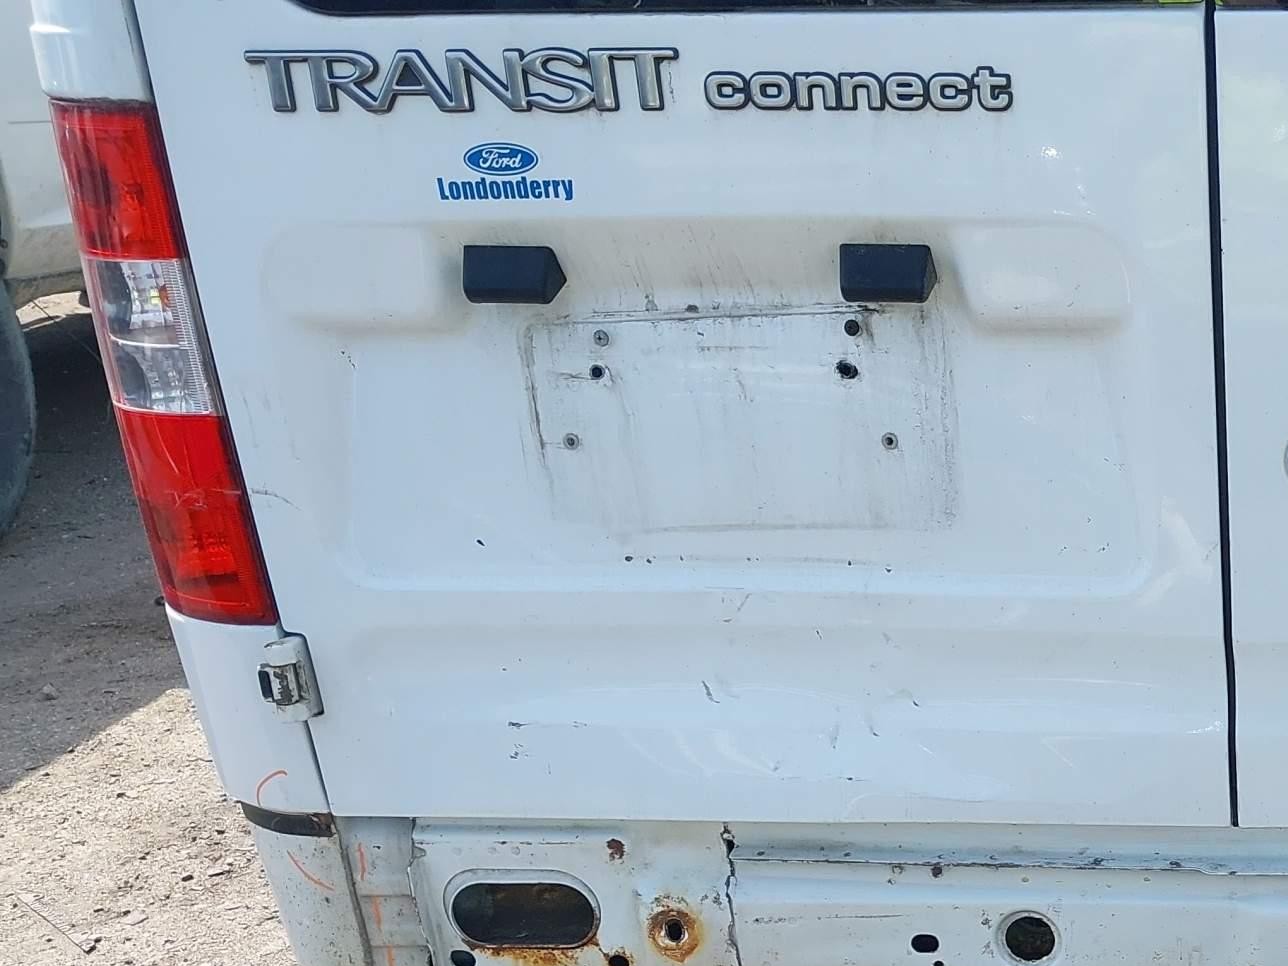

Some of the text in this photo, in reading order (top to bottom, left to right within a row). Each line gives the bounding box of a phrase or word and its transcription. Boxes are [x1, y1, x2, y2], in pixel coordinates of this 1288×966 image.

[244, 47, 1014, 115] TRANSIT connect
[479, 148, 522, 168] Ford
[437, 176, 573, 201] Londonderry
